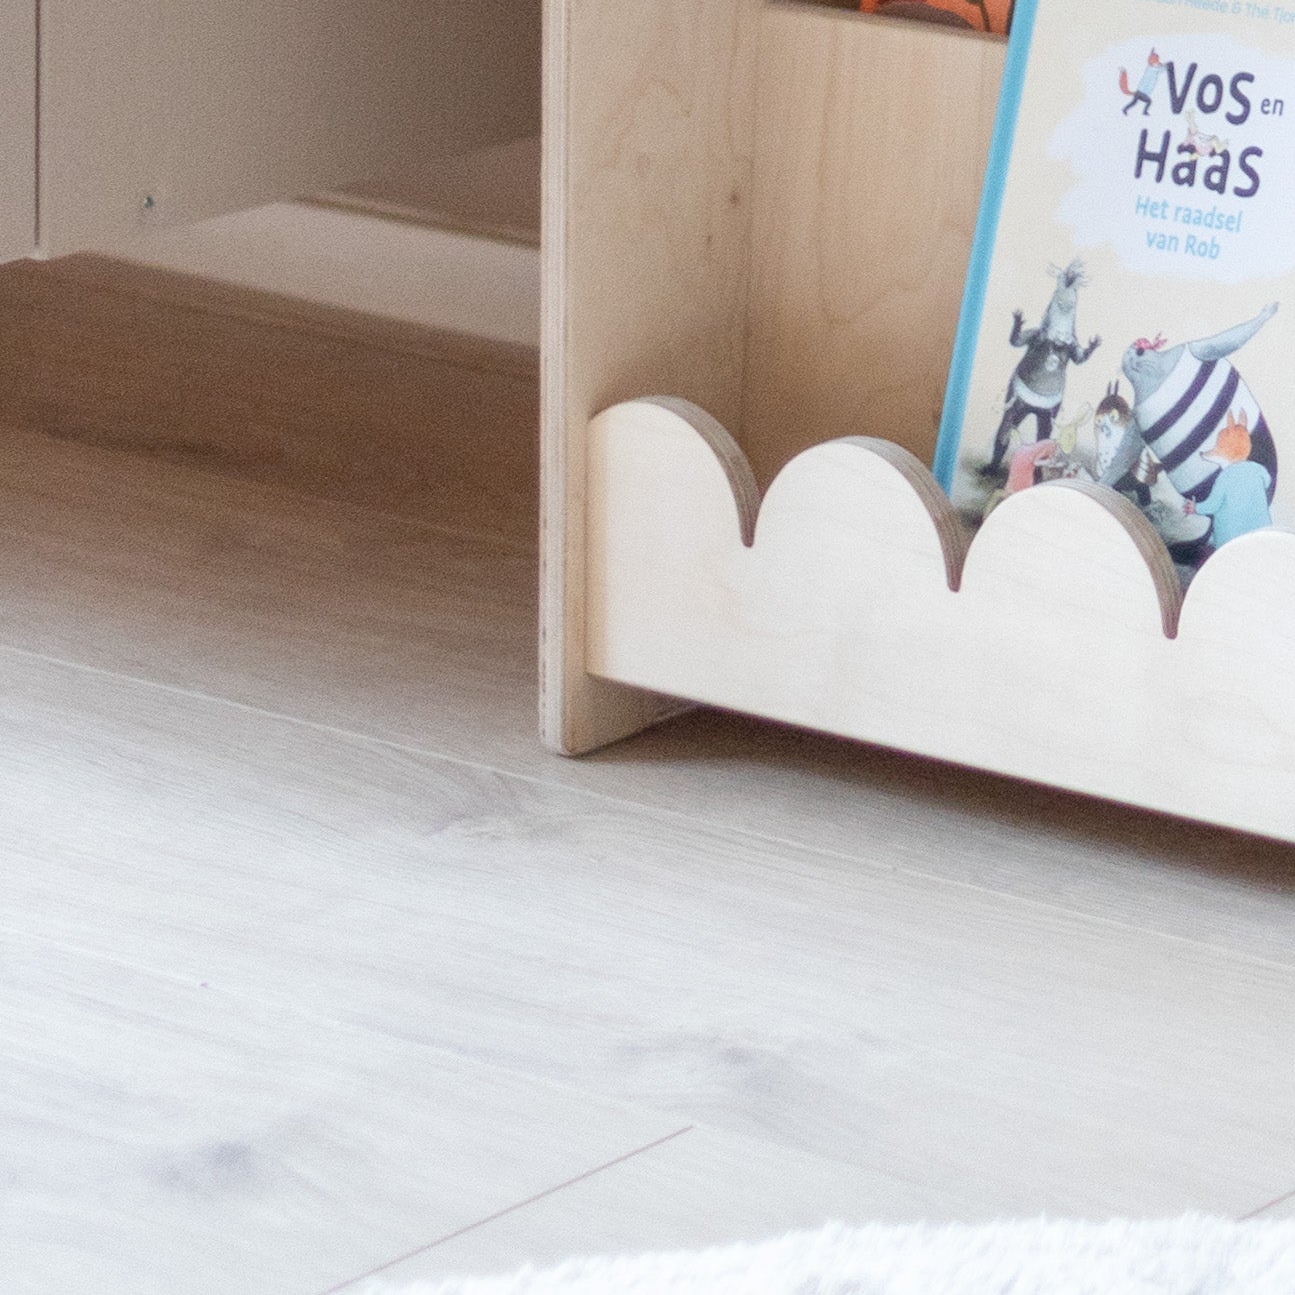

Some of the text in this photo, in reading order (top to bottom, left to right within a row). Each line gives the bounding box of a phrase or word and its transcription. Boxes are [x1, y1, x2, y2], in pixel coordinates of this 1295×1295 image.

[1259, 95, 1285, 118] en
[1134, 195, 1242, 234] Het raadsel
[1145, 230, 1220, 260] van Rob
